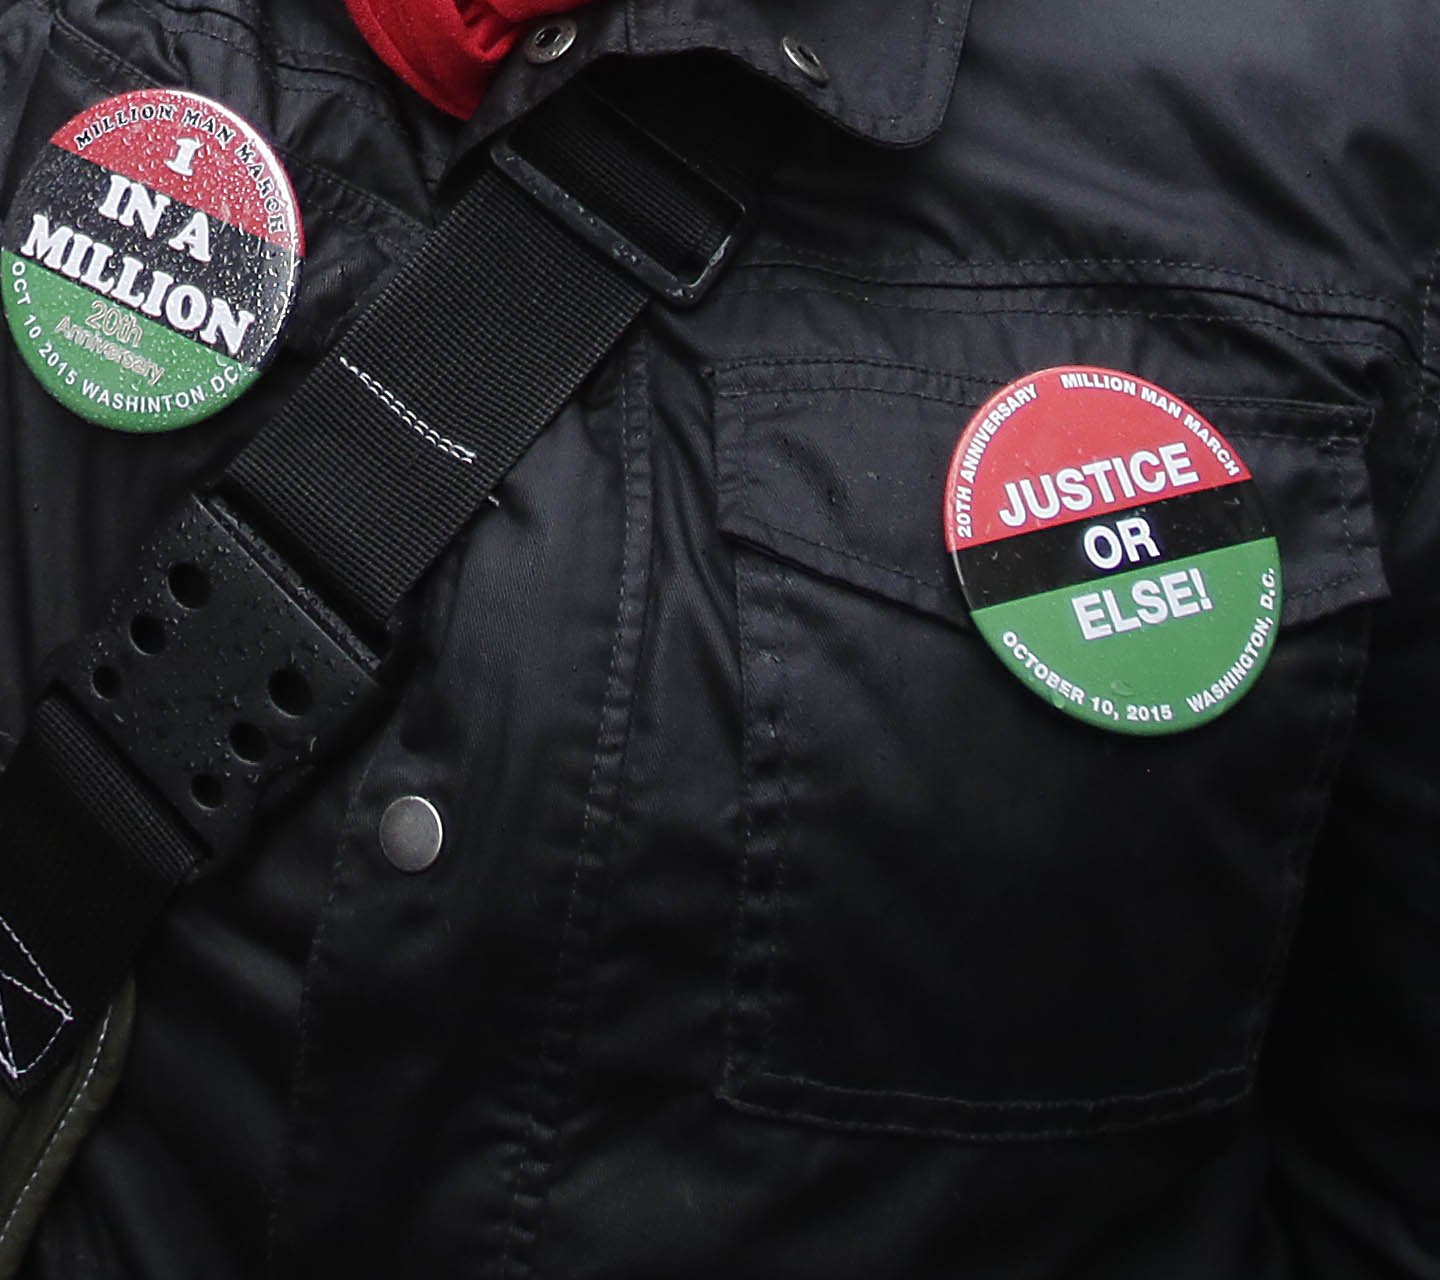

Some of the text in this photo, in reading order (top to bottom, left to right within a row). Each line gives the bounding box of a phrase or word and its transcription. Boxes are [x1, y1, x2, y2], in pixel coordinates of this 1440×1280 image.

[75, 104, 286, 234] MILLION MAN MARCH
[97, 174, 212, 262] IN A
[21, 214, 255, 356] MILLION
[85, 300, 144, 348] 20th
[11, 261, 32, 307] OCT
[23, 313, 42, 339] 10
[38, 342, 78, 387] 2015
[80, 378, 207, 414] WASHINTON
[54, 315, 165, 387] Anniversary
[955, 373, 1242, 538] 20TH ANNIVERSARY MILLION MAN MARCH
[997, 441, 1200, 529] JUSTICE
[1082, 516, 1161, 571] OR
[1001, 567, 1278, 722] OCTOBER 10, 2015 WASHINGTON, D.C.
[1070, 567, 1214, 642] ELSE!
